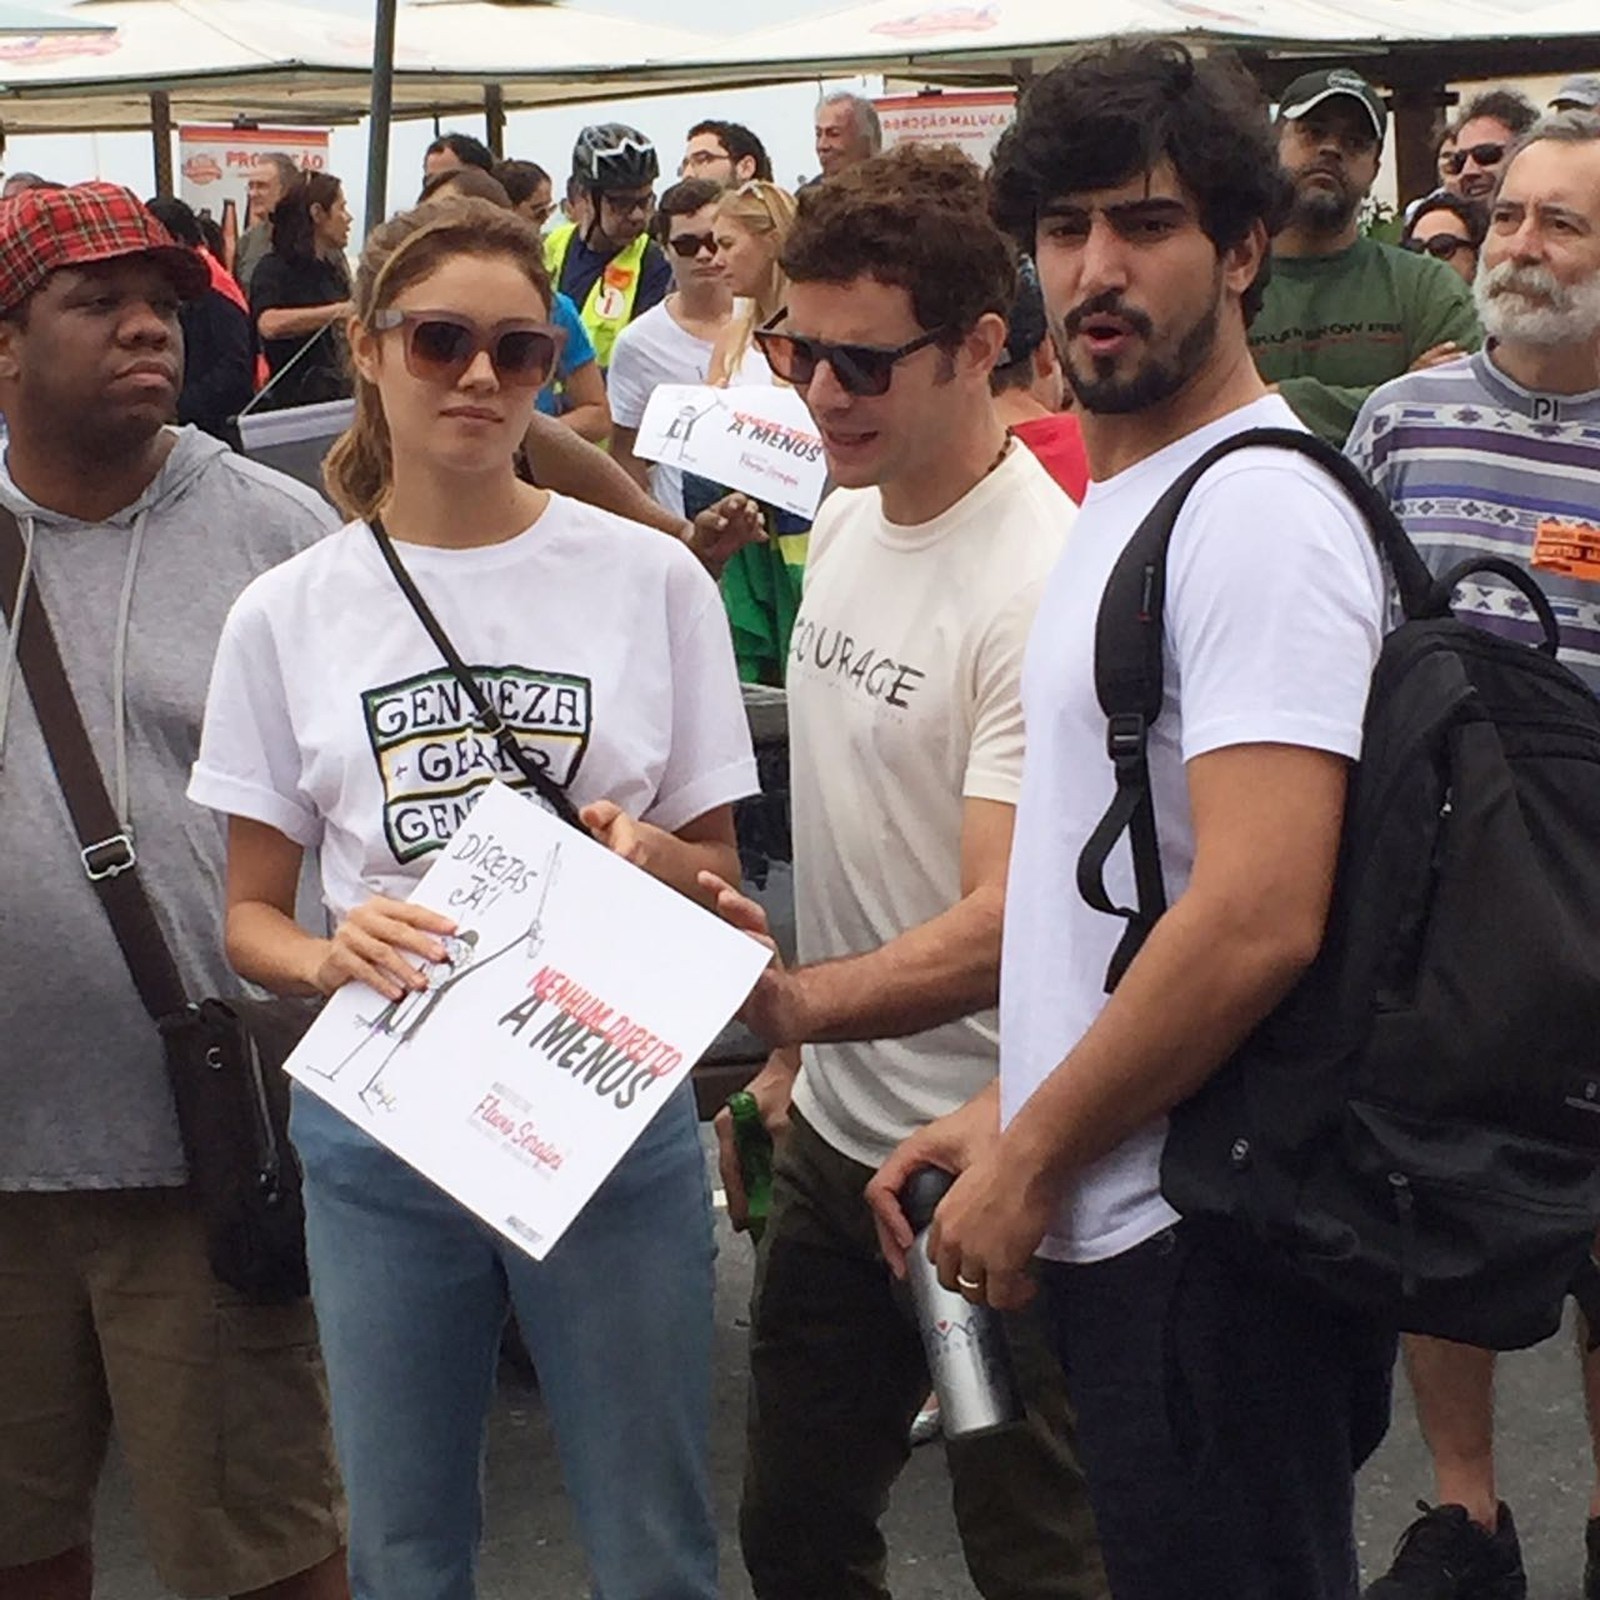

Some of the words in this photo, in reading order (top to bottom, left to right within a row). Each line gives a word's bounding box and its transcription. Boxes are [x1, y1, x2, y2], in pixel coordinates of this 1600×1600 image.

[883, 113, 947, 131] ROMOÇÃO
[950, 113, 1006, 127] MALUCA
[225, 150, 324, 170] PROÃO
[727, 419, 744, 436] A
[749, 424, 822, 463] MENOS
[375, 679, 582, 738] GENEZA
[452, 833, 538, 894] DIRETAS
[498, 991, 546, 1037] A
[529, 1007, 660, 1110] MENOS
[526, 965, 614, 1036] NENHUM
[606, 1015, 682, 1077] DIREITO
